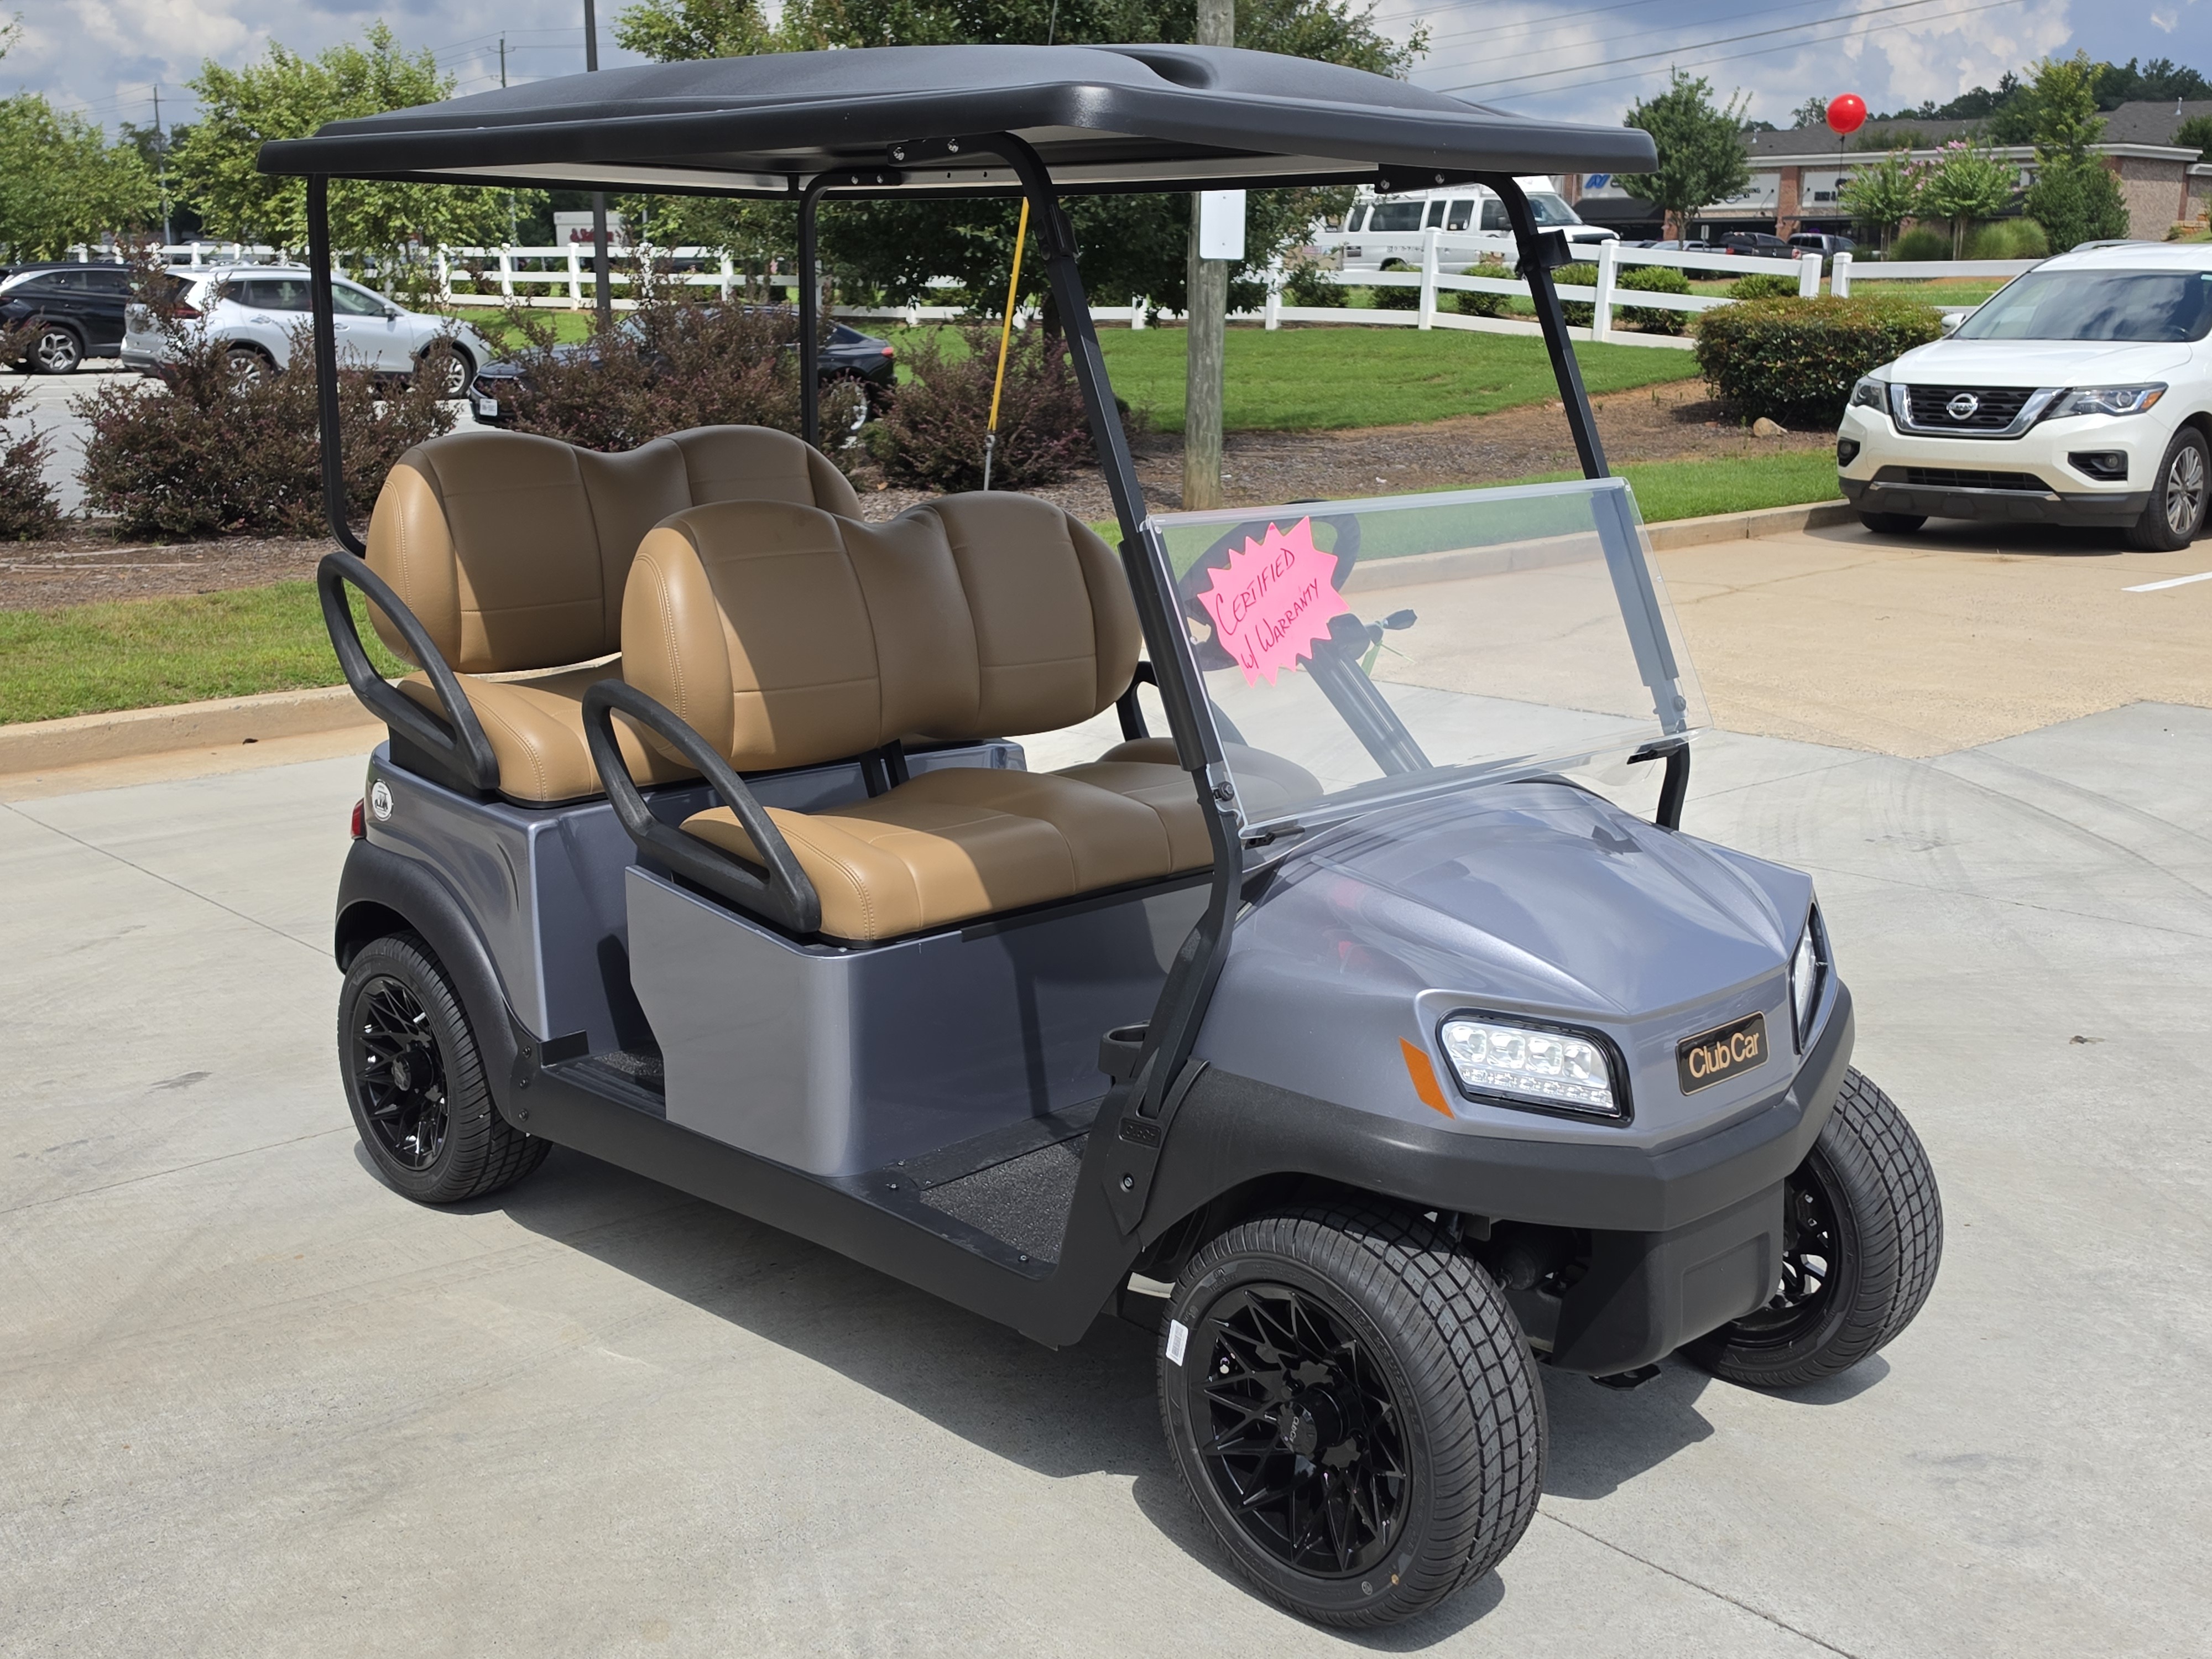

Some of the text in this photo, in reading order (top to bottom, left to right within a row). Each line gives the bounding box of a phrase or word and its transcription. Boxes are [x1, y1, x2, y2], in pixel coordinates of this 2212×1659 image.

[1216, 547, 1295, 635] CERTIFIED
[1255, 578, 1319, 652] WARRANTY
[1689, 1032, 1759, 1078] Club Car
